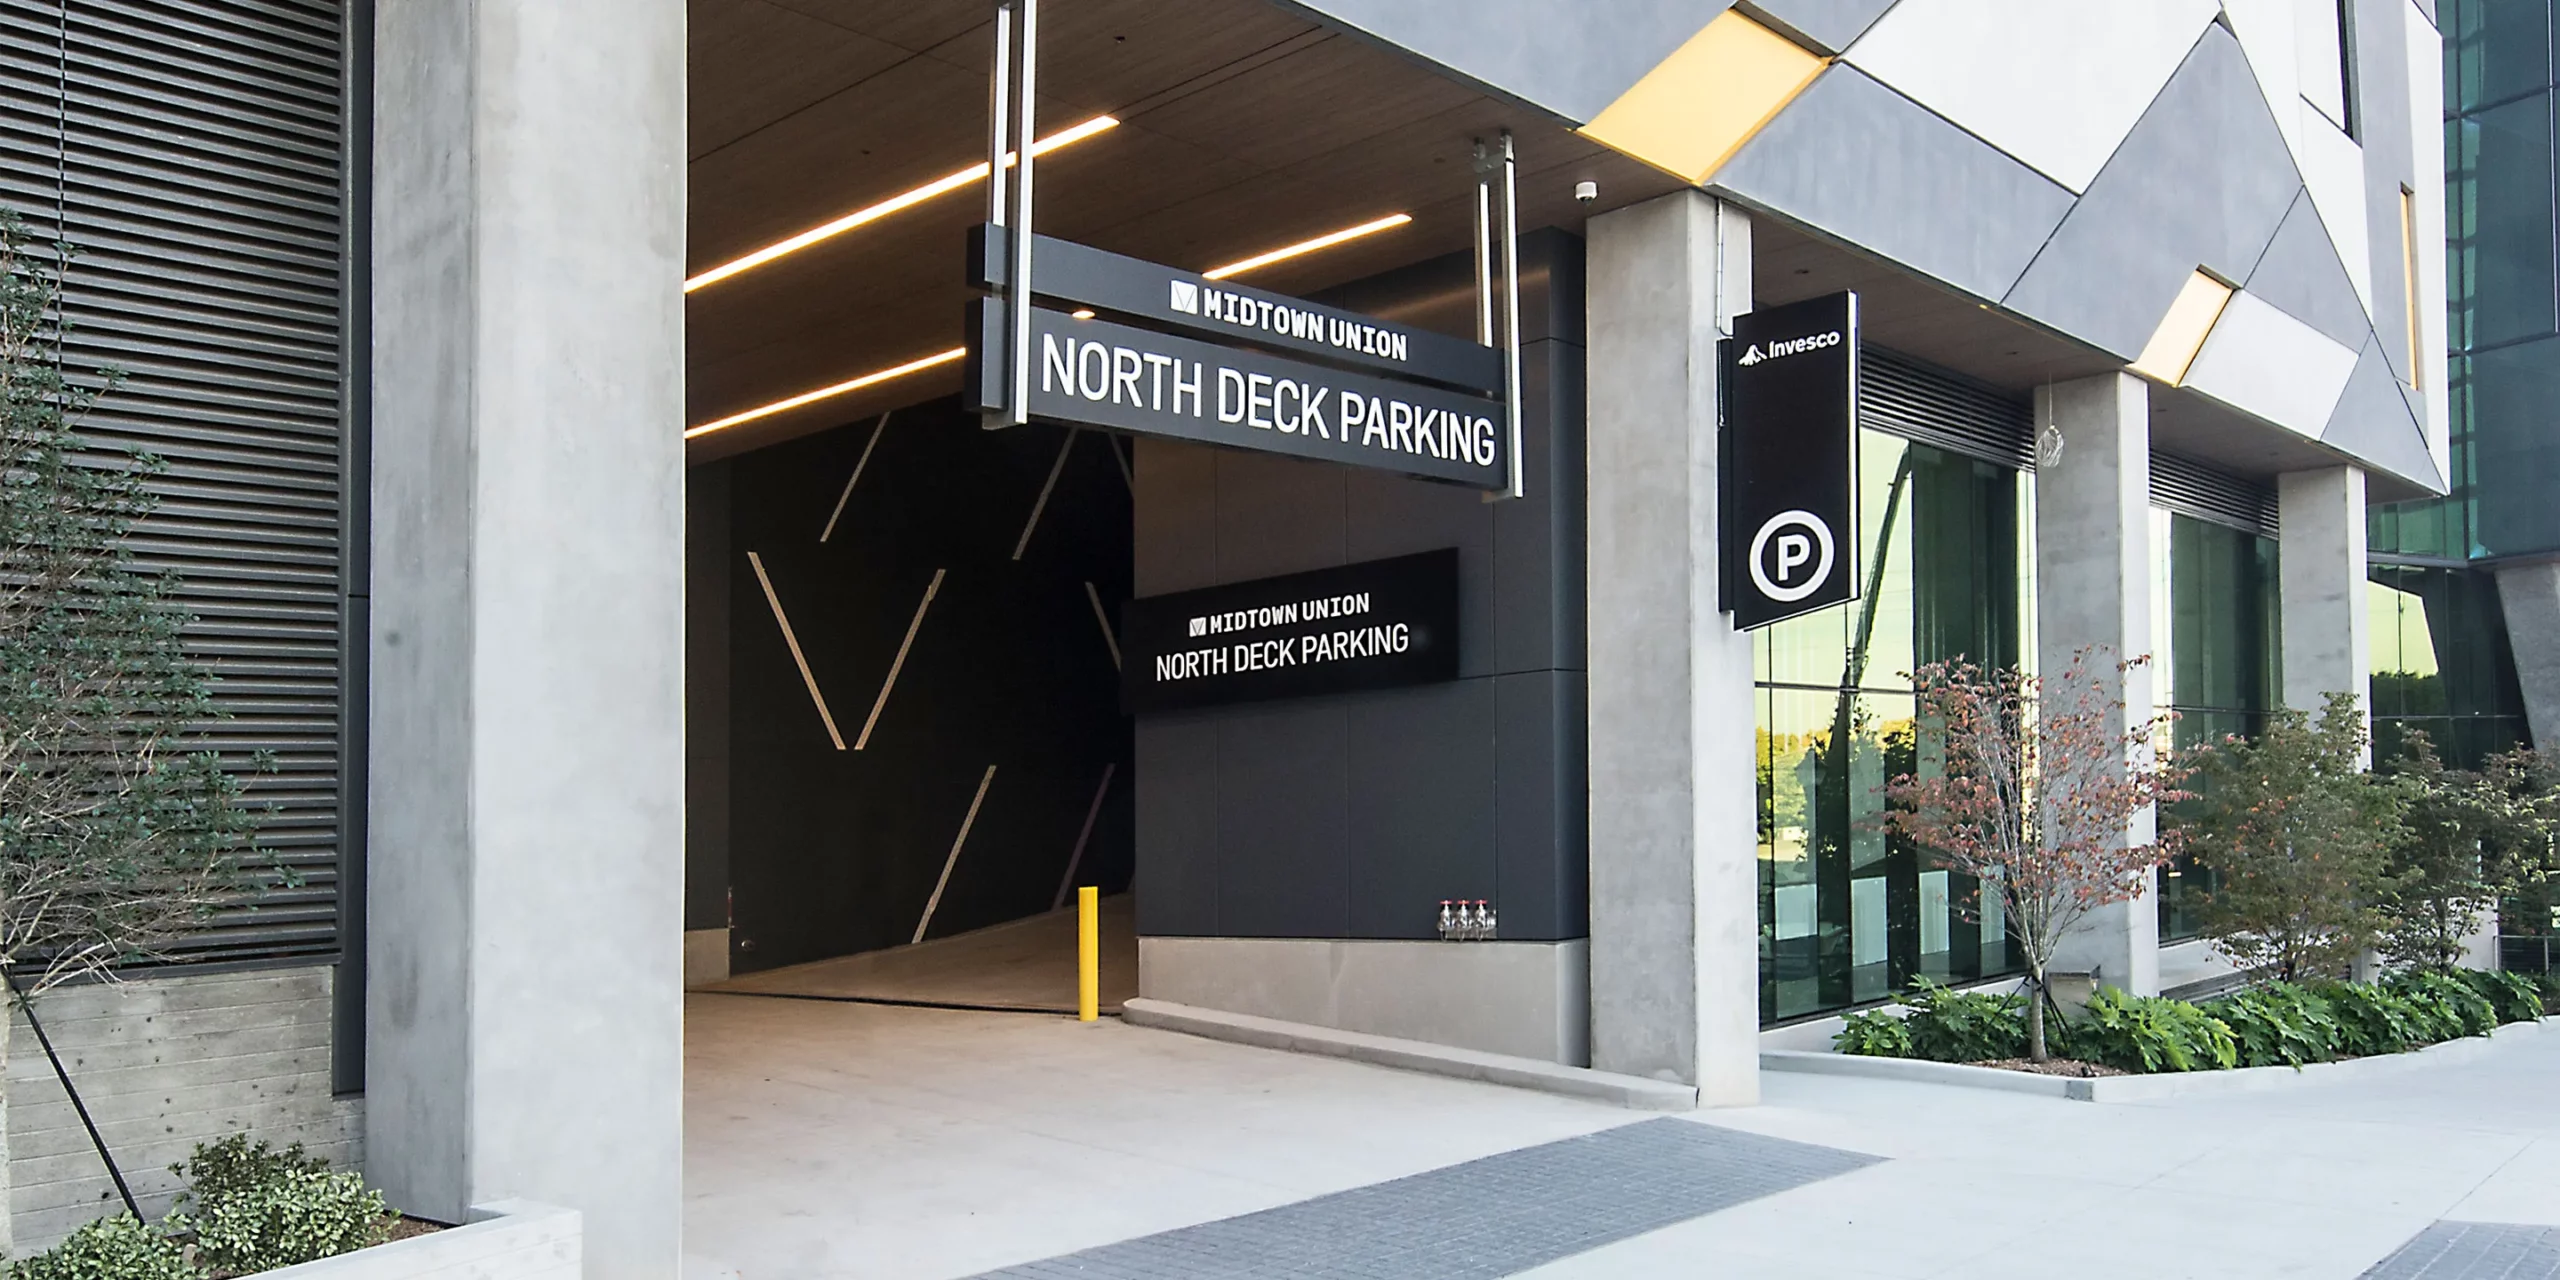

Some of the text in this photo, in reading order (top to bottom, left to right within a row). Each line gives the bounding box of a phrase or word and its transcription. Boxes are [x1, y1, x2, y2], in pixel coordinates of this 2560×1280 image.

[1203, 287, 1407, 362] MIDTOWN UNION
[1769, 331, 1841, 359] Invesco
[1042, 332, 1495, 466] NORTH DECK PARKING
[1777, 533, 1812, 582] P
[1210, 592, 1370, 634] MIDTOWN UNION
[1156, 623, 1409, 682] NORTH DECK PARKING
